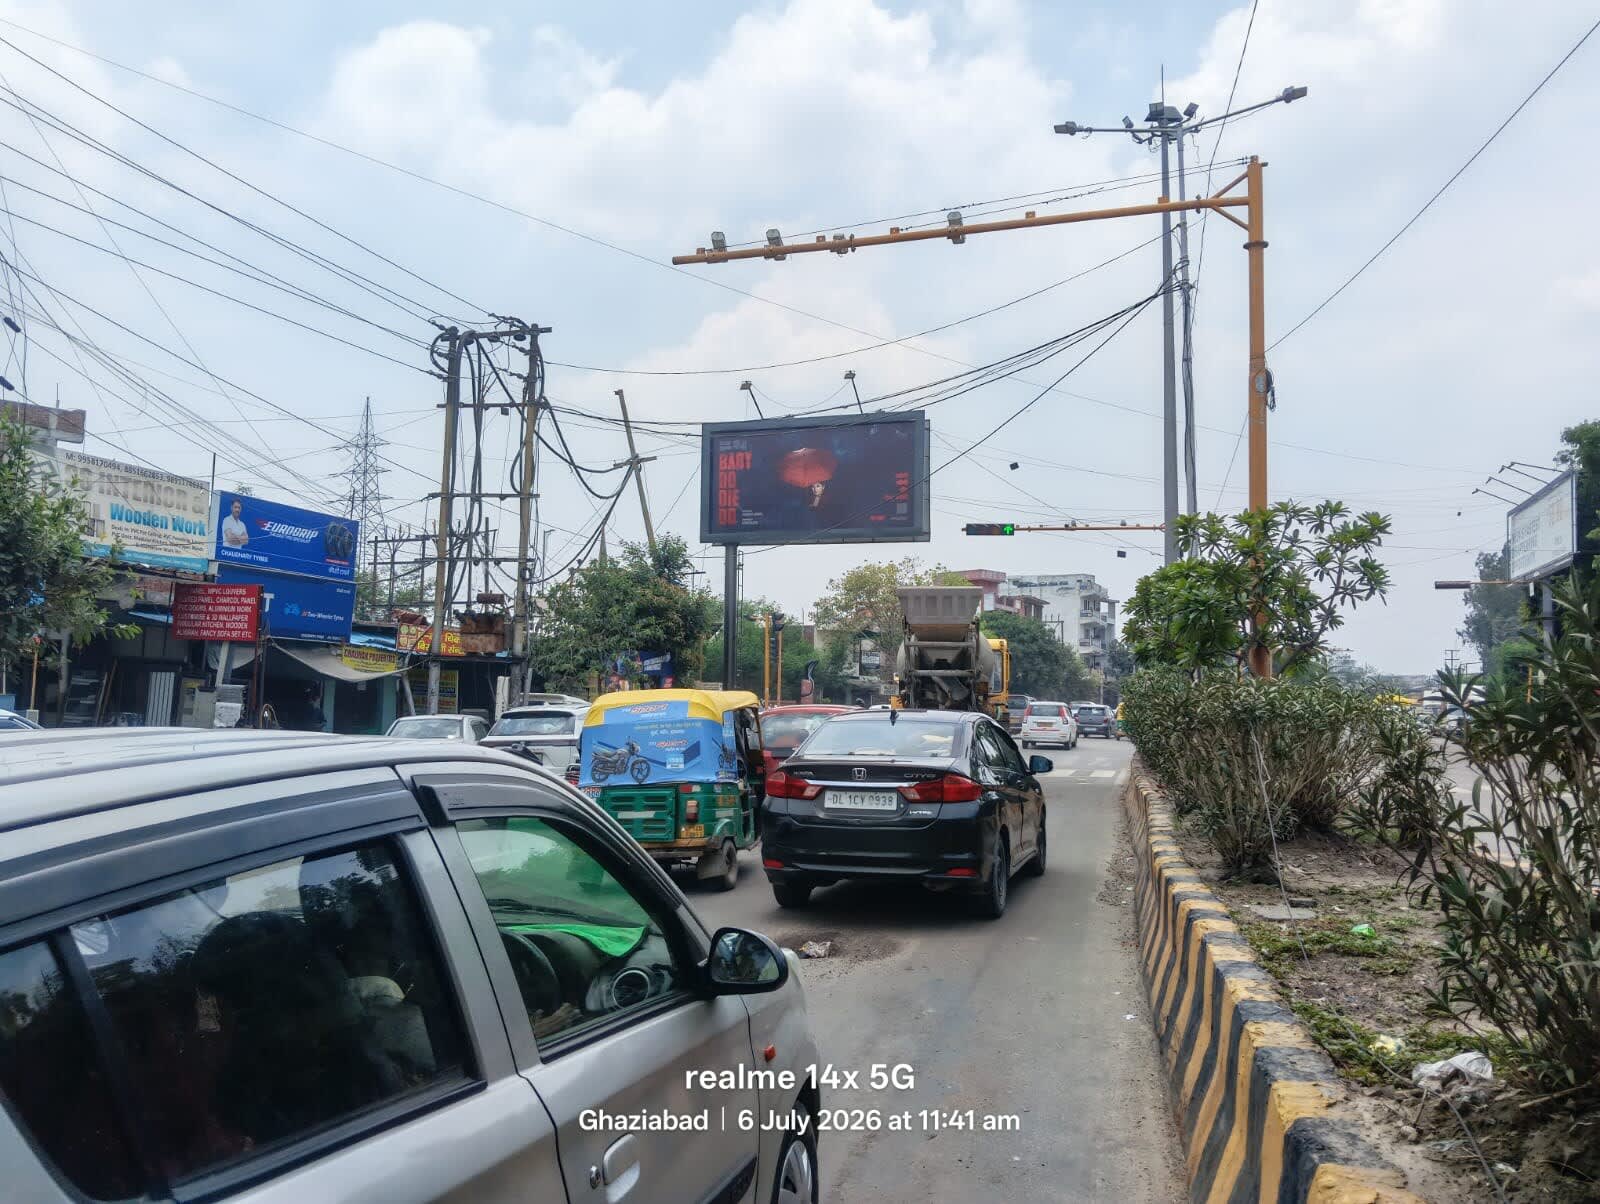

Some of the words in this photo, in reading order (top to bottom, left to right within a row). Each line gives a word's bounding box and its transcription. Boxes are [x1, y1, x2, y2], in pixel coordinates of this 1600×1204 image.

[109, 502, 169, 530] Wooden
[171, 514, 206, 537] Work
[262, 520, 319, 539] EUROGRIP
[240, 597, 257, 605] PANEL
[832, 793, 845, 805] DL
[848, 794, 865, 806] 1CY
